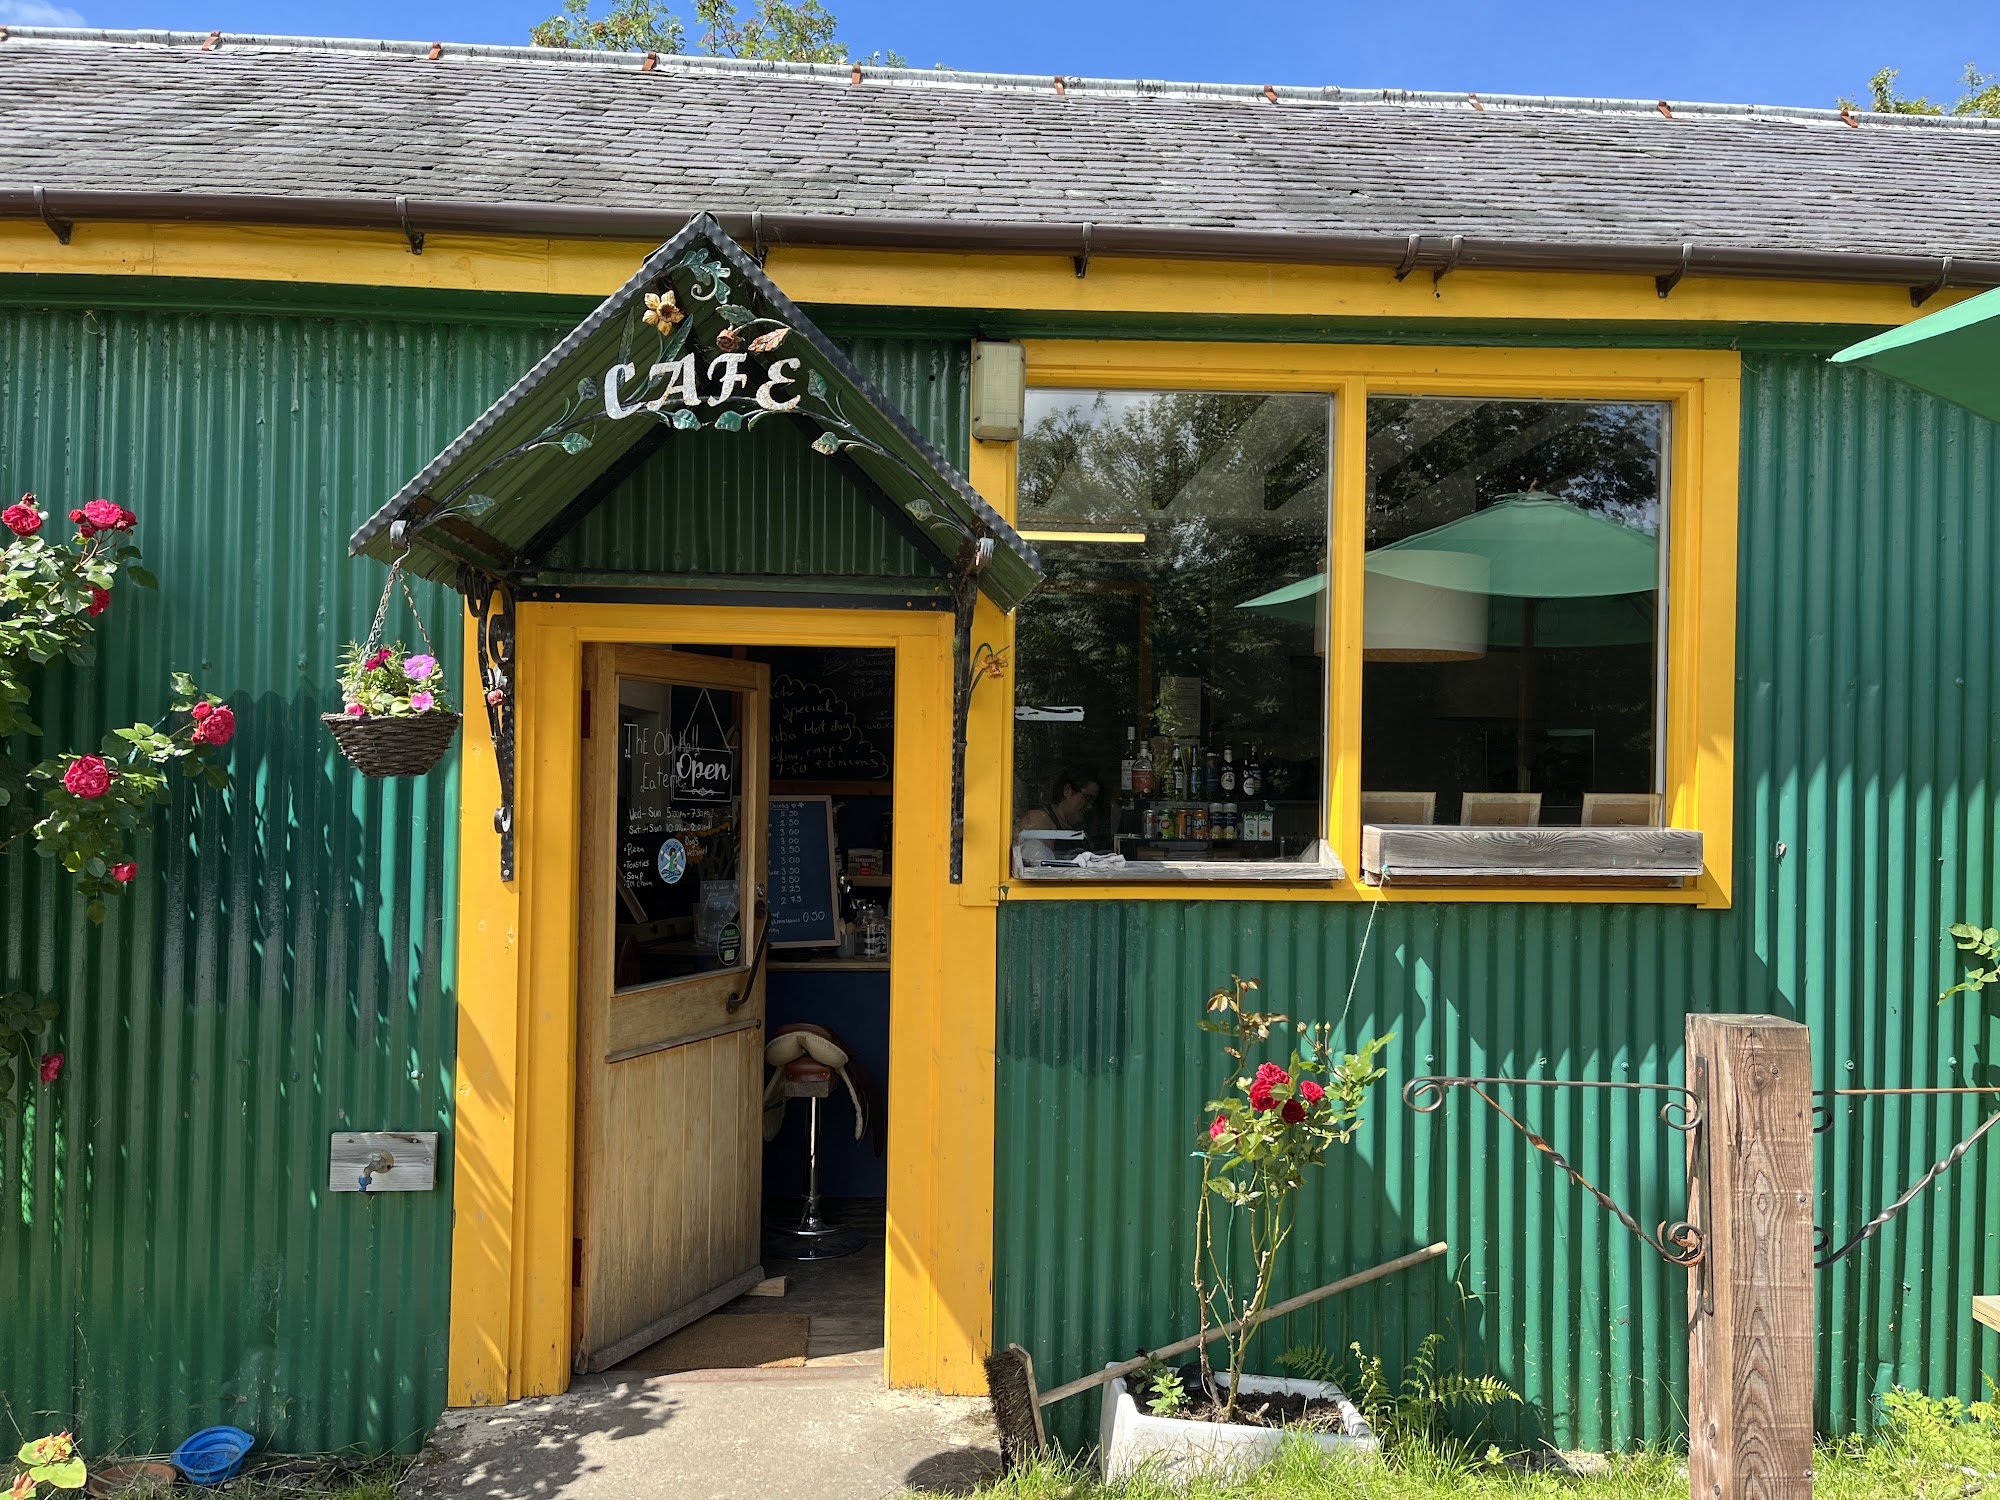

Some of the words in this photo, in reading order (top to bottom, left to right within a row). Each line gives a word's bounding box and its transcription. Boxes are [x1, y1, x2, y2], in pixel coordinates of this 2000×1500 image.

[782, 698, 833, 724] Special
[831, 719, 852, 741] dog
[676, 753, 731, 787] Open
